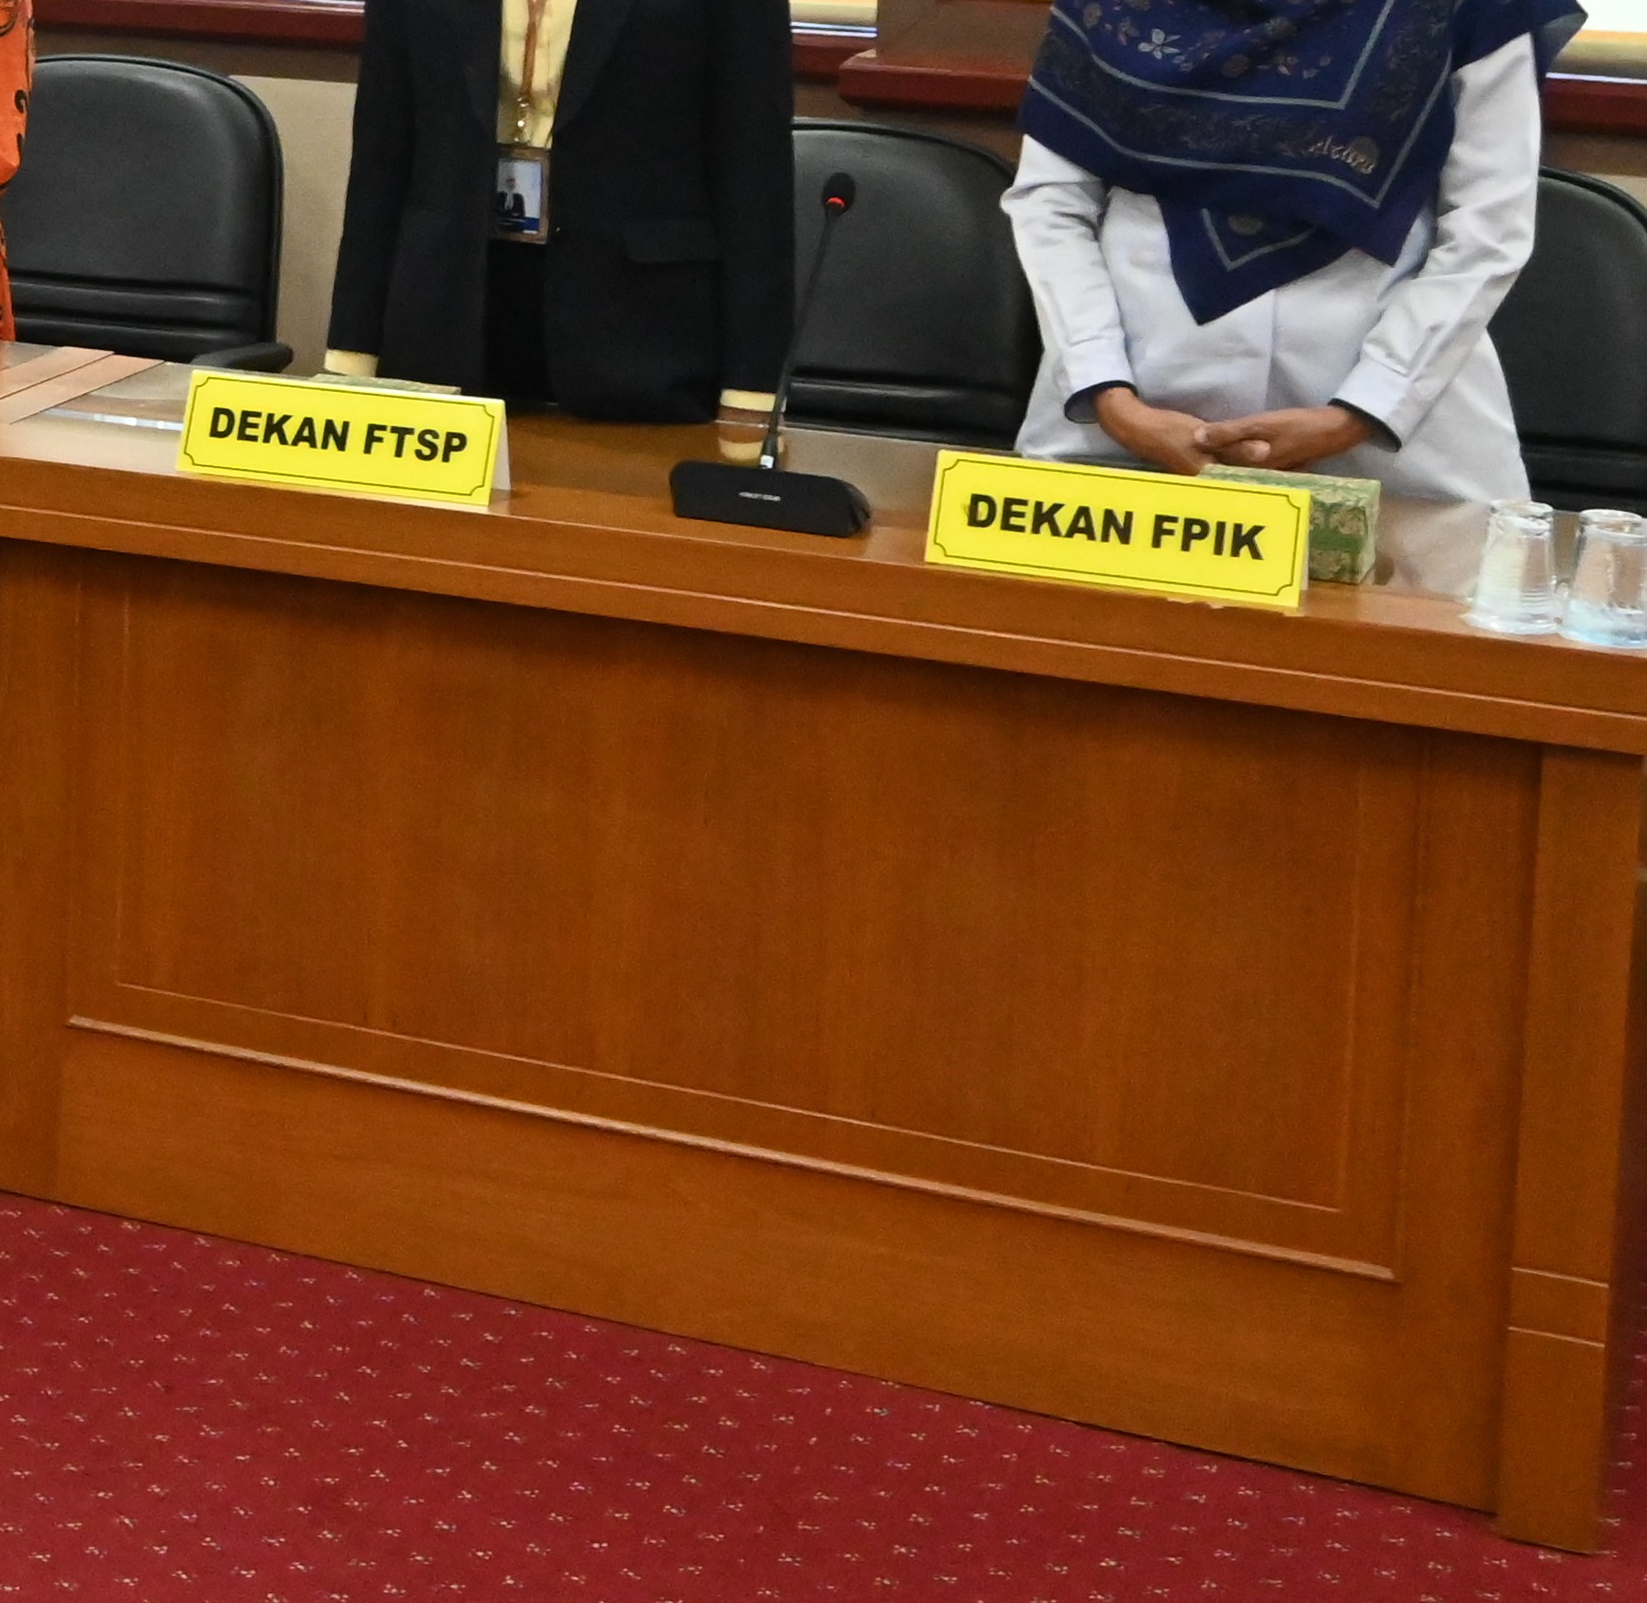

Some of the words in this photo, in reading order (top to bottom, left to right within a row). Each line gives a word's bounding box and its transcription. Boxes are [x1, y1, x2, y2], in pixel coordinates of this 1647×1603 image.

[208, 406, 351, 452] DEKAN
[363, 422, 469, 464] FTSP
[966, 492, 1134, 546] DEKAN
[1150, 514, 1267, 561] FPIK
